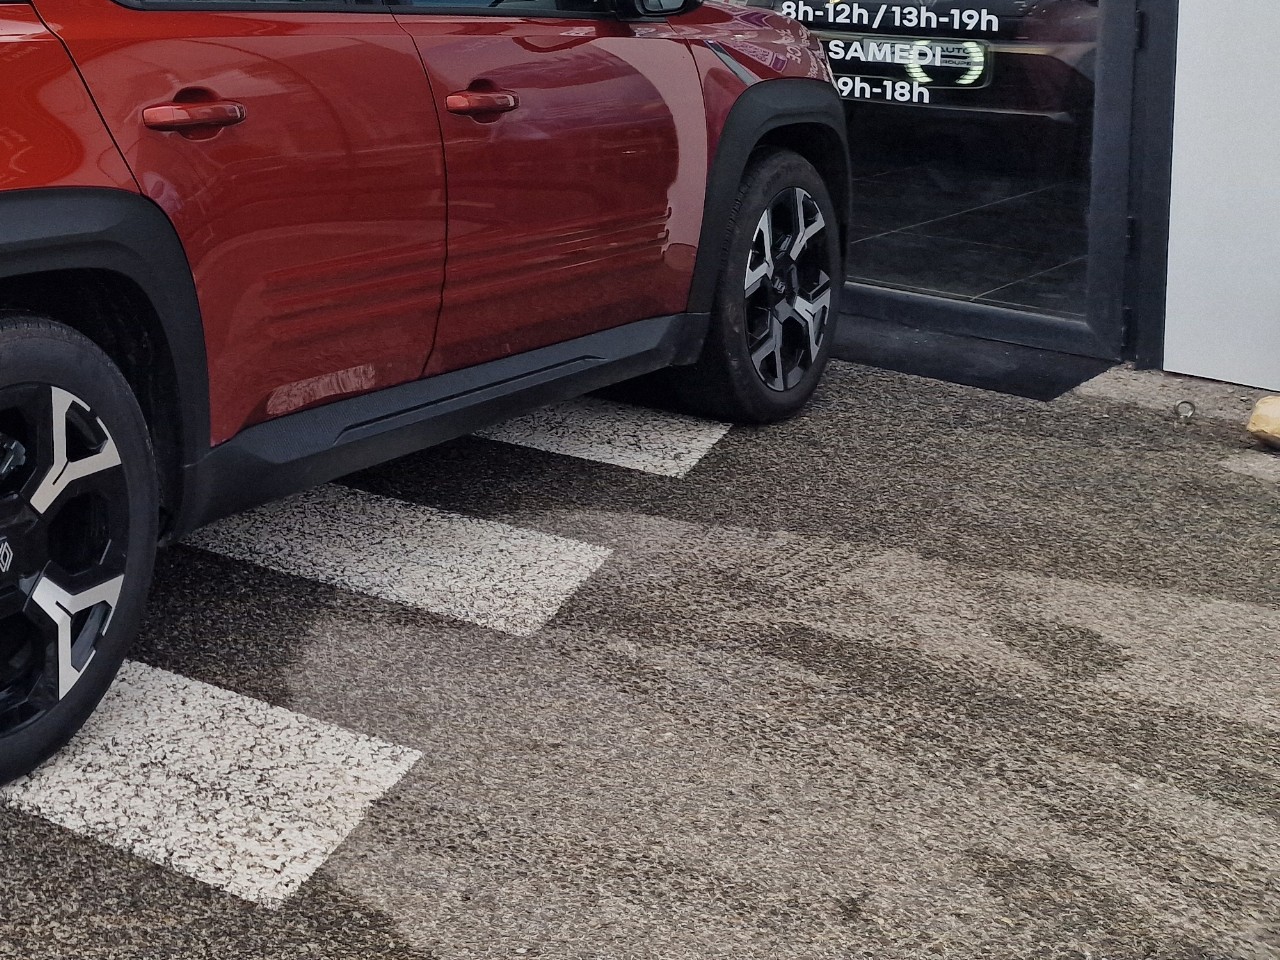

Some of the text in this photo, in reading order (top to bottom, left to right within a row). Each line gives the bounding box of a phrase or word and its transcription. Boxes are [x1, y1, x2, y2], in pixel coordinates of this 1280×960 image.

[781, 1, 869, 25] 8h-12h
[892, 6, 999, 32] 13h-19h
[828, 40, 942, 67] SAMEDI
[838, 77, 930, 104] 9h-18h
